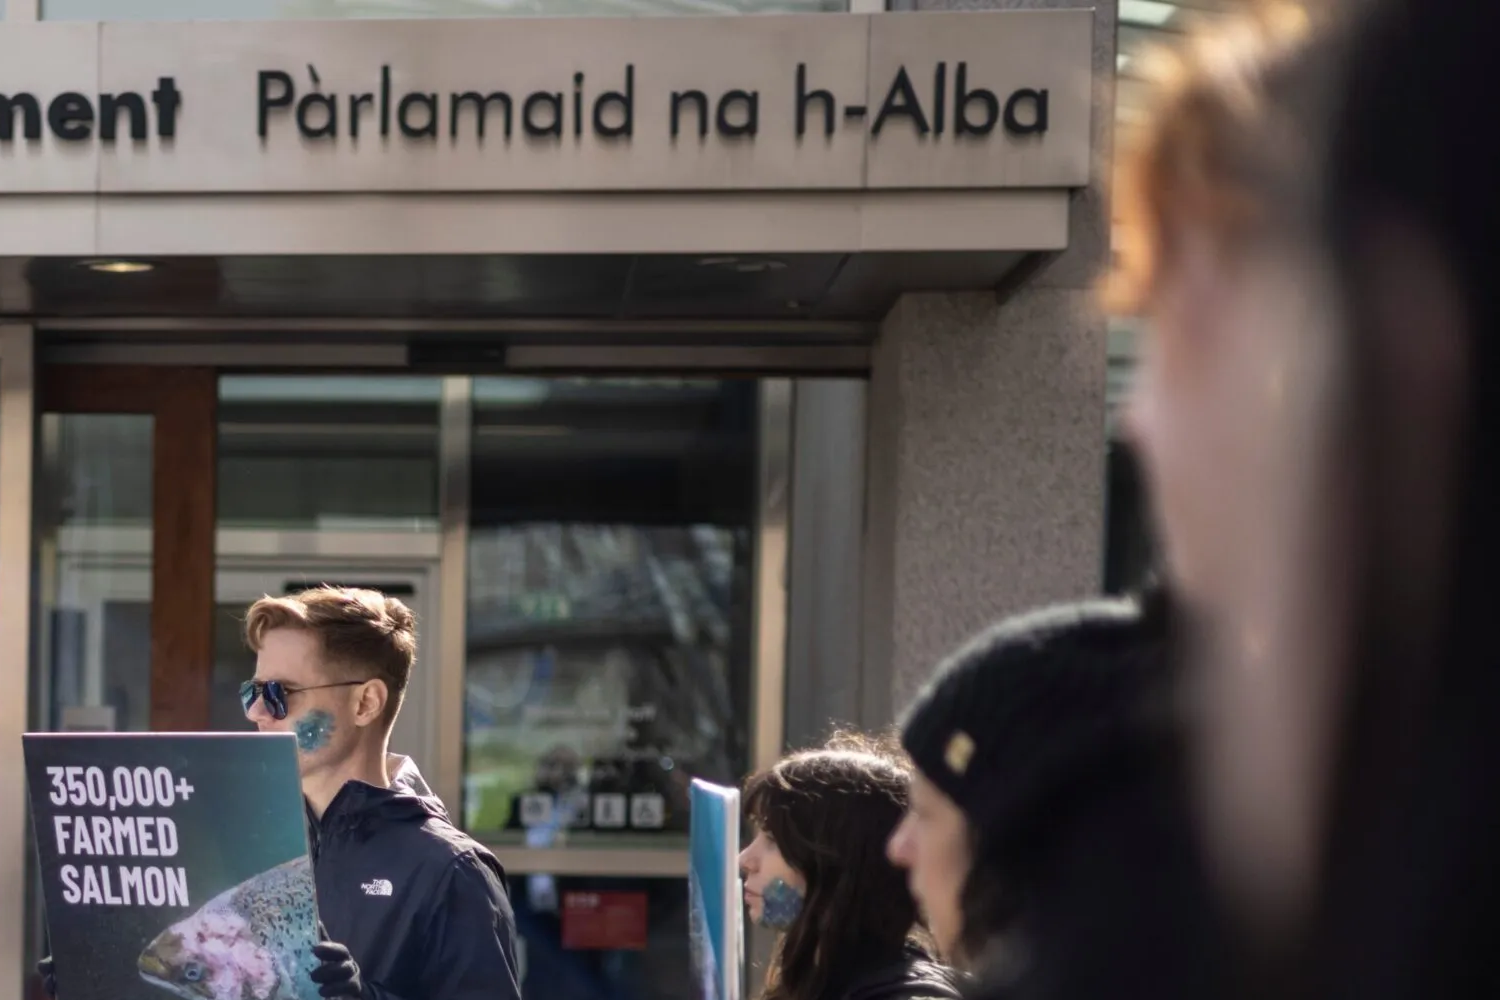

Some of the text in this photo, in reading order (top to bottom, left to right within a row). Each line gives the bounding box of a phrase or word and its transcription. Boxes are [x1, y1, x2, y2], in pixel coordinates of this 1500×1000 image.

[258, 61, 1049, 140] Pàrlamaid na h-Alba
[46, 766, 195, 812] 350,000+
[53, 815, 179, 857] FARMED
[60, 864, 190, 908] SALMON
